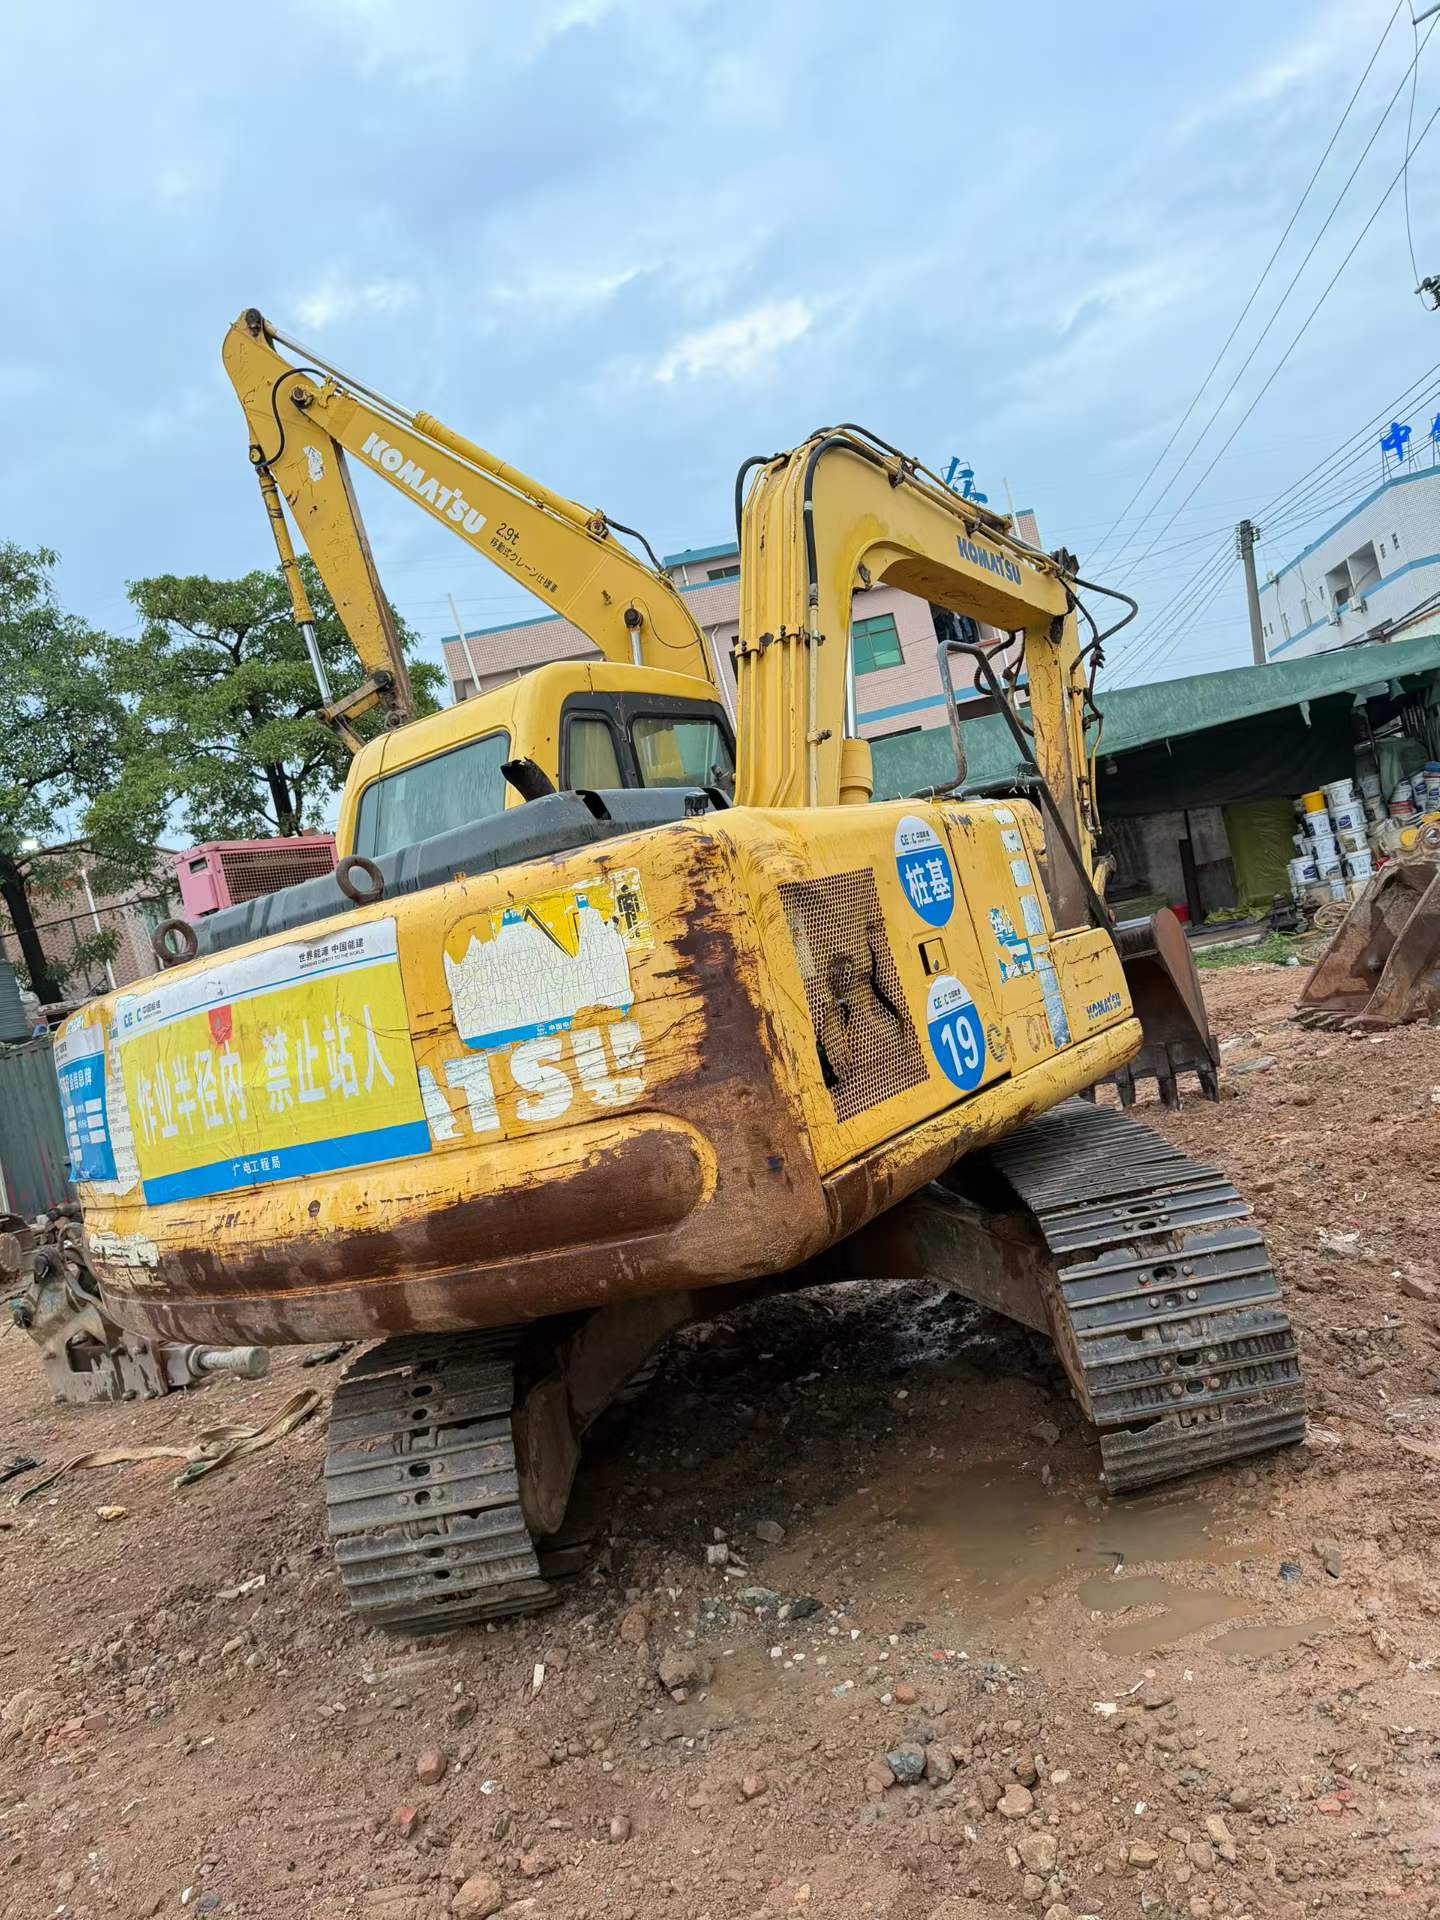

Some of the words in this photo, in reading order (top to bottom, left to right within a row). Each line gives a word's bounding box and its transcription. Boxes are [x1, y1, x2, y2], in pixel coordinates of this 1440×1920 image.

[361, 432, 487, 534] KOMATSU
[956, 535, 1022, 586] KOMATSU
[905, 857, 951, 908] 桩基
[298, 946, 329, 963] 世界能源
[331, 937, 364, 953] 中国能建
[1087, 992, 1121, 1020] KOMATSU
[941, 1016, 979, 1076] 19
[136, 1040, 247, 1146] 作业半径内
[262, 1004, 396, 1115] 禁止站人
